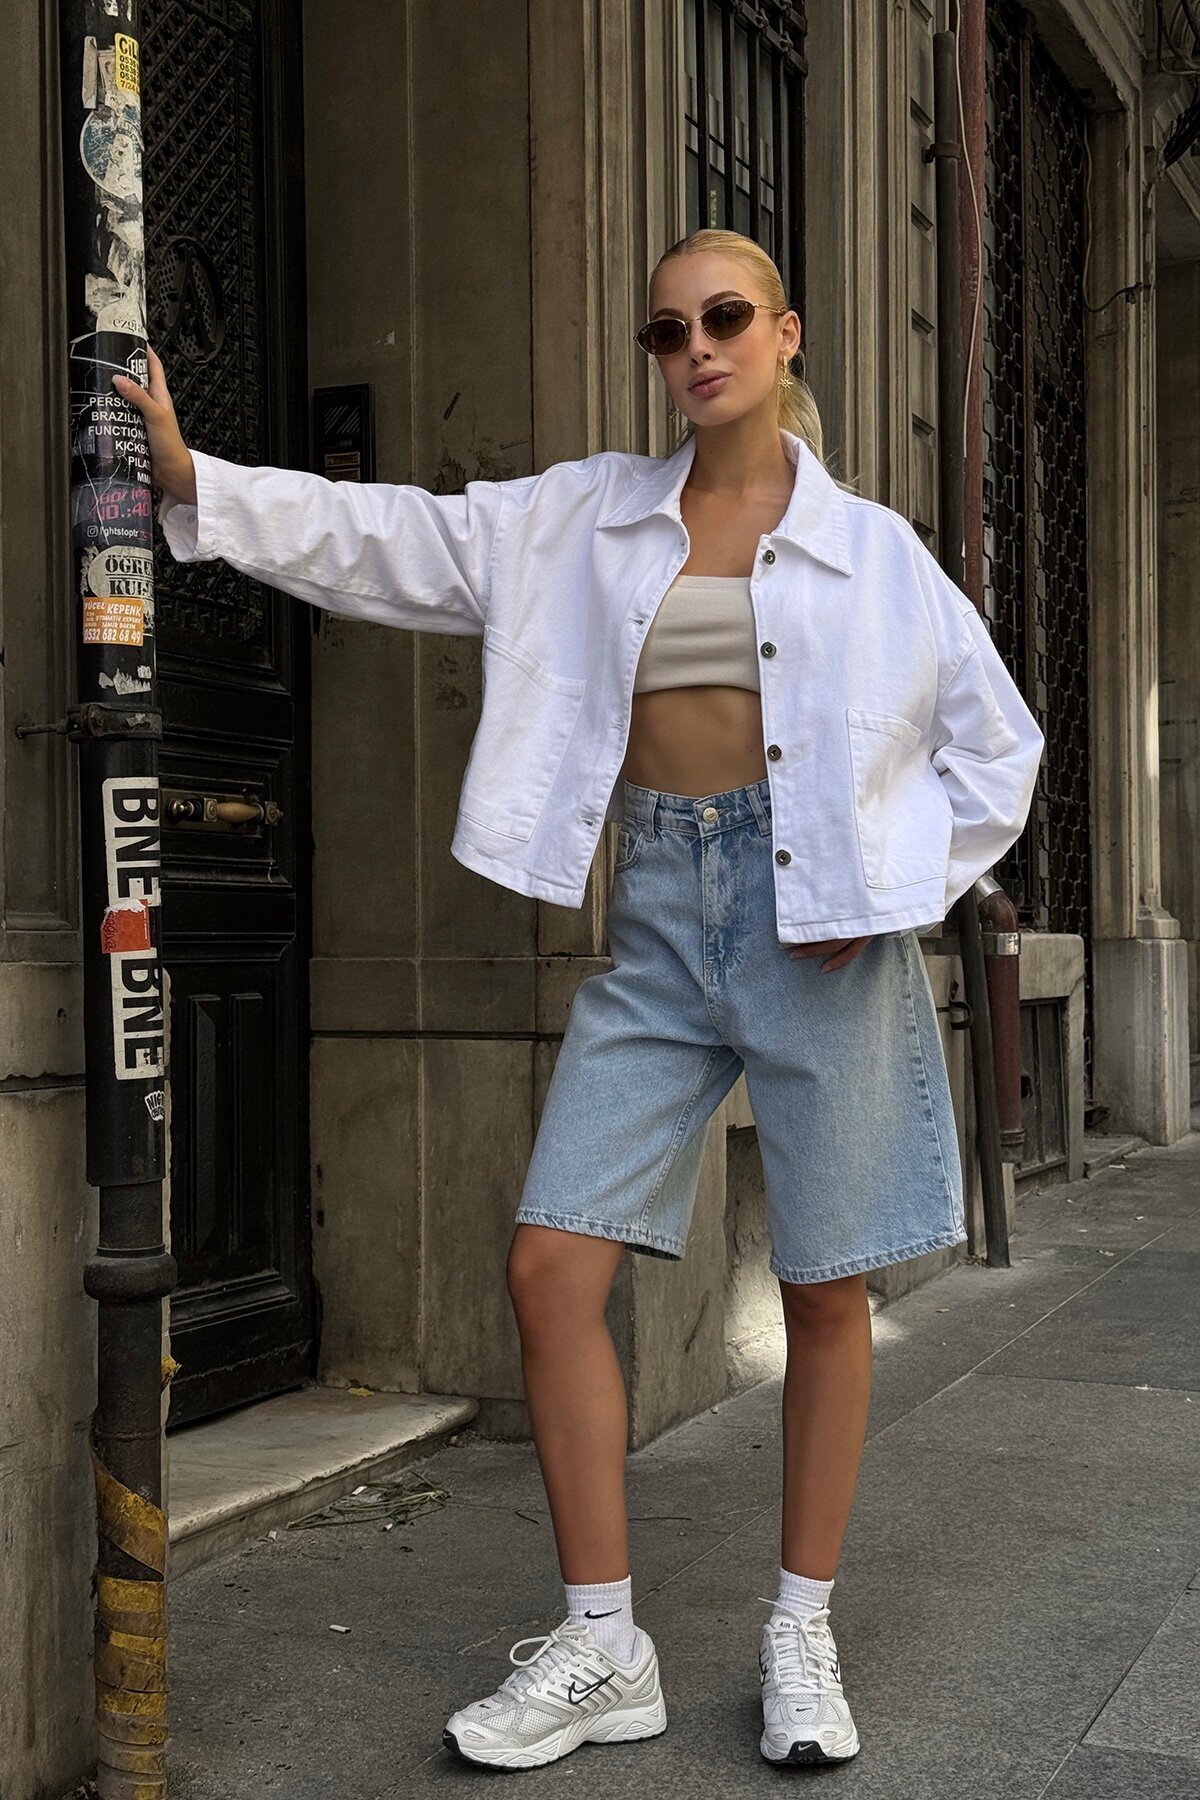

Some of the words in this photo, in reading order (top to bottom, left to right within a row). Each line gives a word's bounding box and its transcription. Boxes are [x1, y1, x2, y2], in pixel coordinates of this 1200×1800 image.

[102, 628, 117, 641] 682
[119, 629, 130, 642] 68
[106, 603, 141, 617] KEPENK
[111, 788, 160, 898] BNE
[121, 958, 163, 1070] BNE
